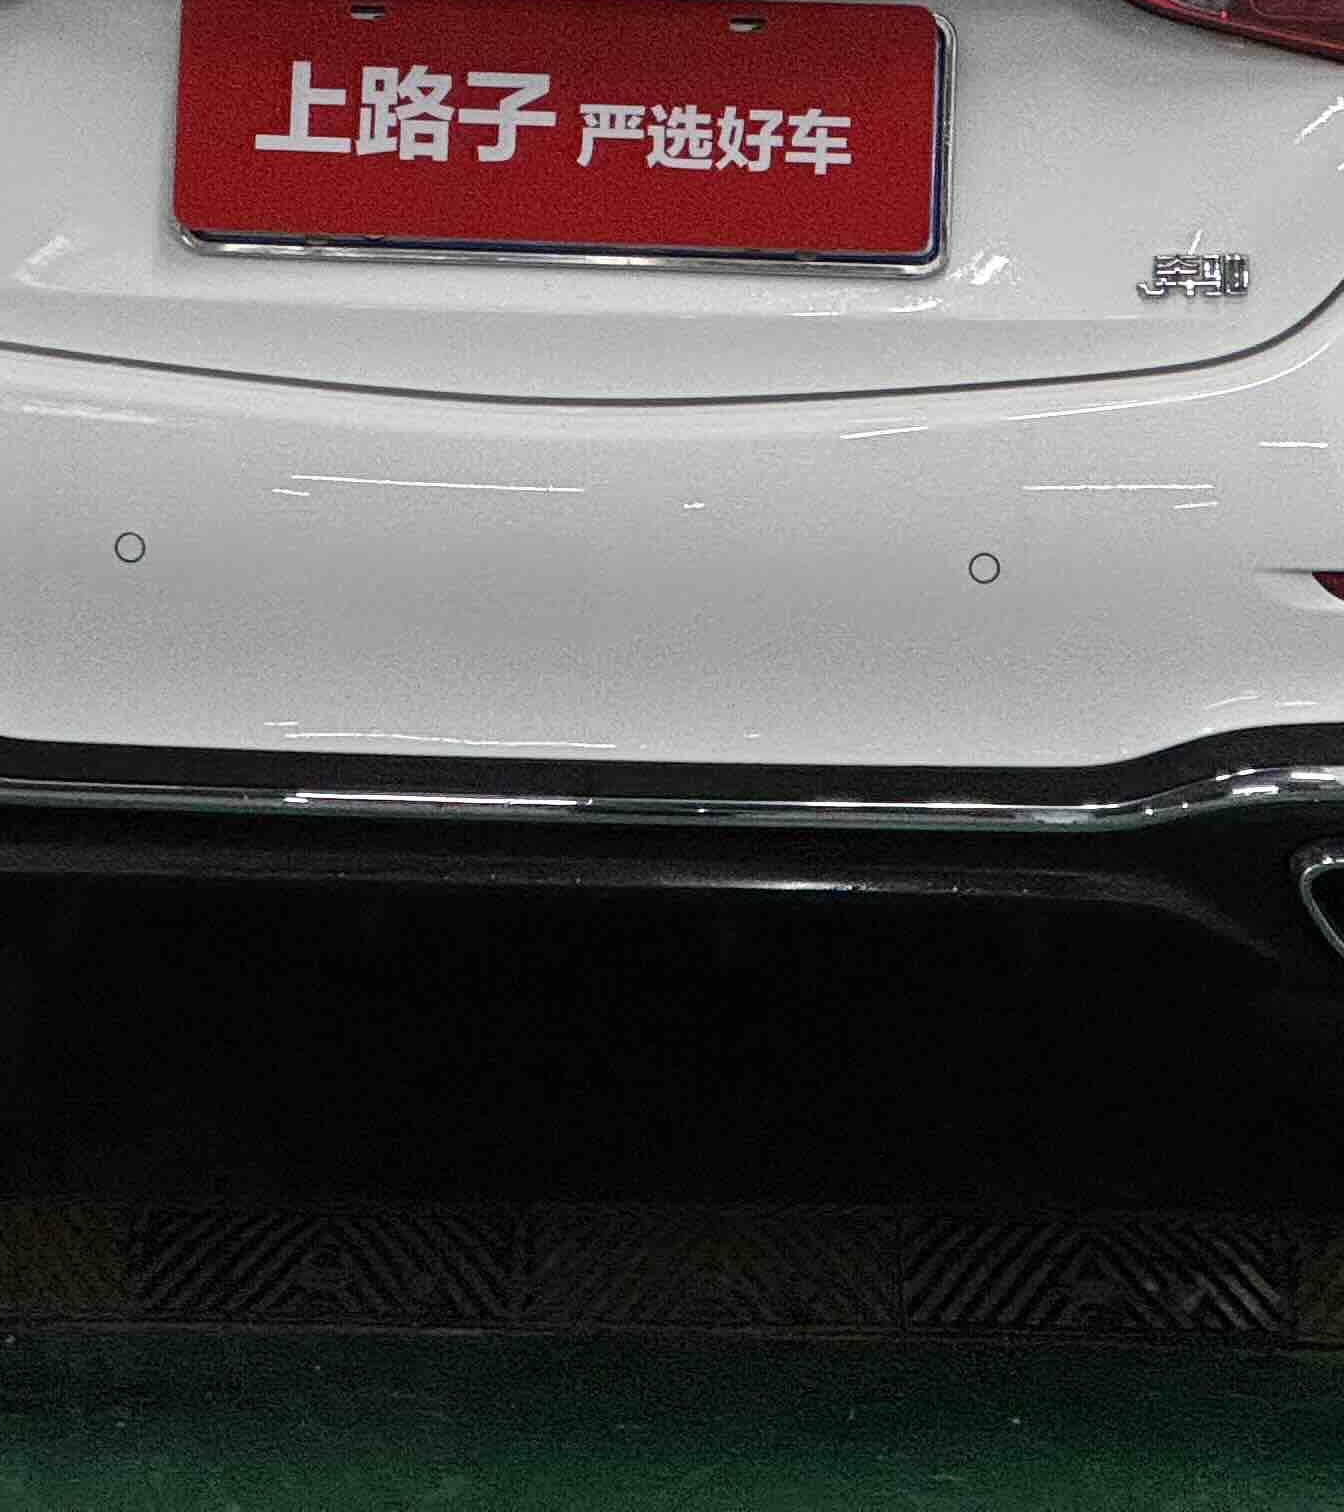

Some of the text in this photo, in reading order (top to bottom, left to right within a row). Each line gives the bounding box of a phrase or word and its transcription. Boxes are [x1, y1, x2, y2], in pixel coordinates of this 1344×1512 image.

[255, 61, 851, 176] 上路子 严选好车
[1136, 255, 1249, 298] 奔驰
